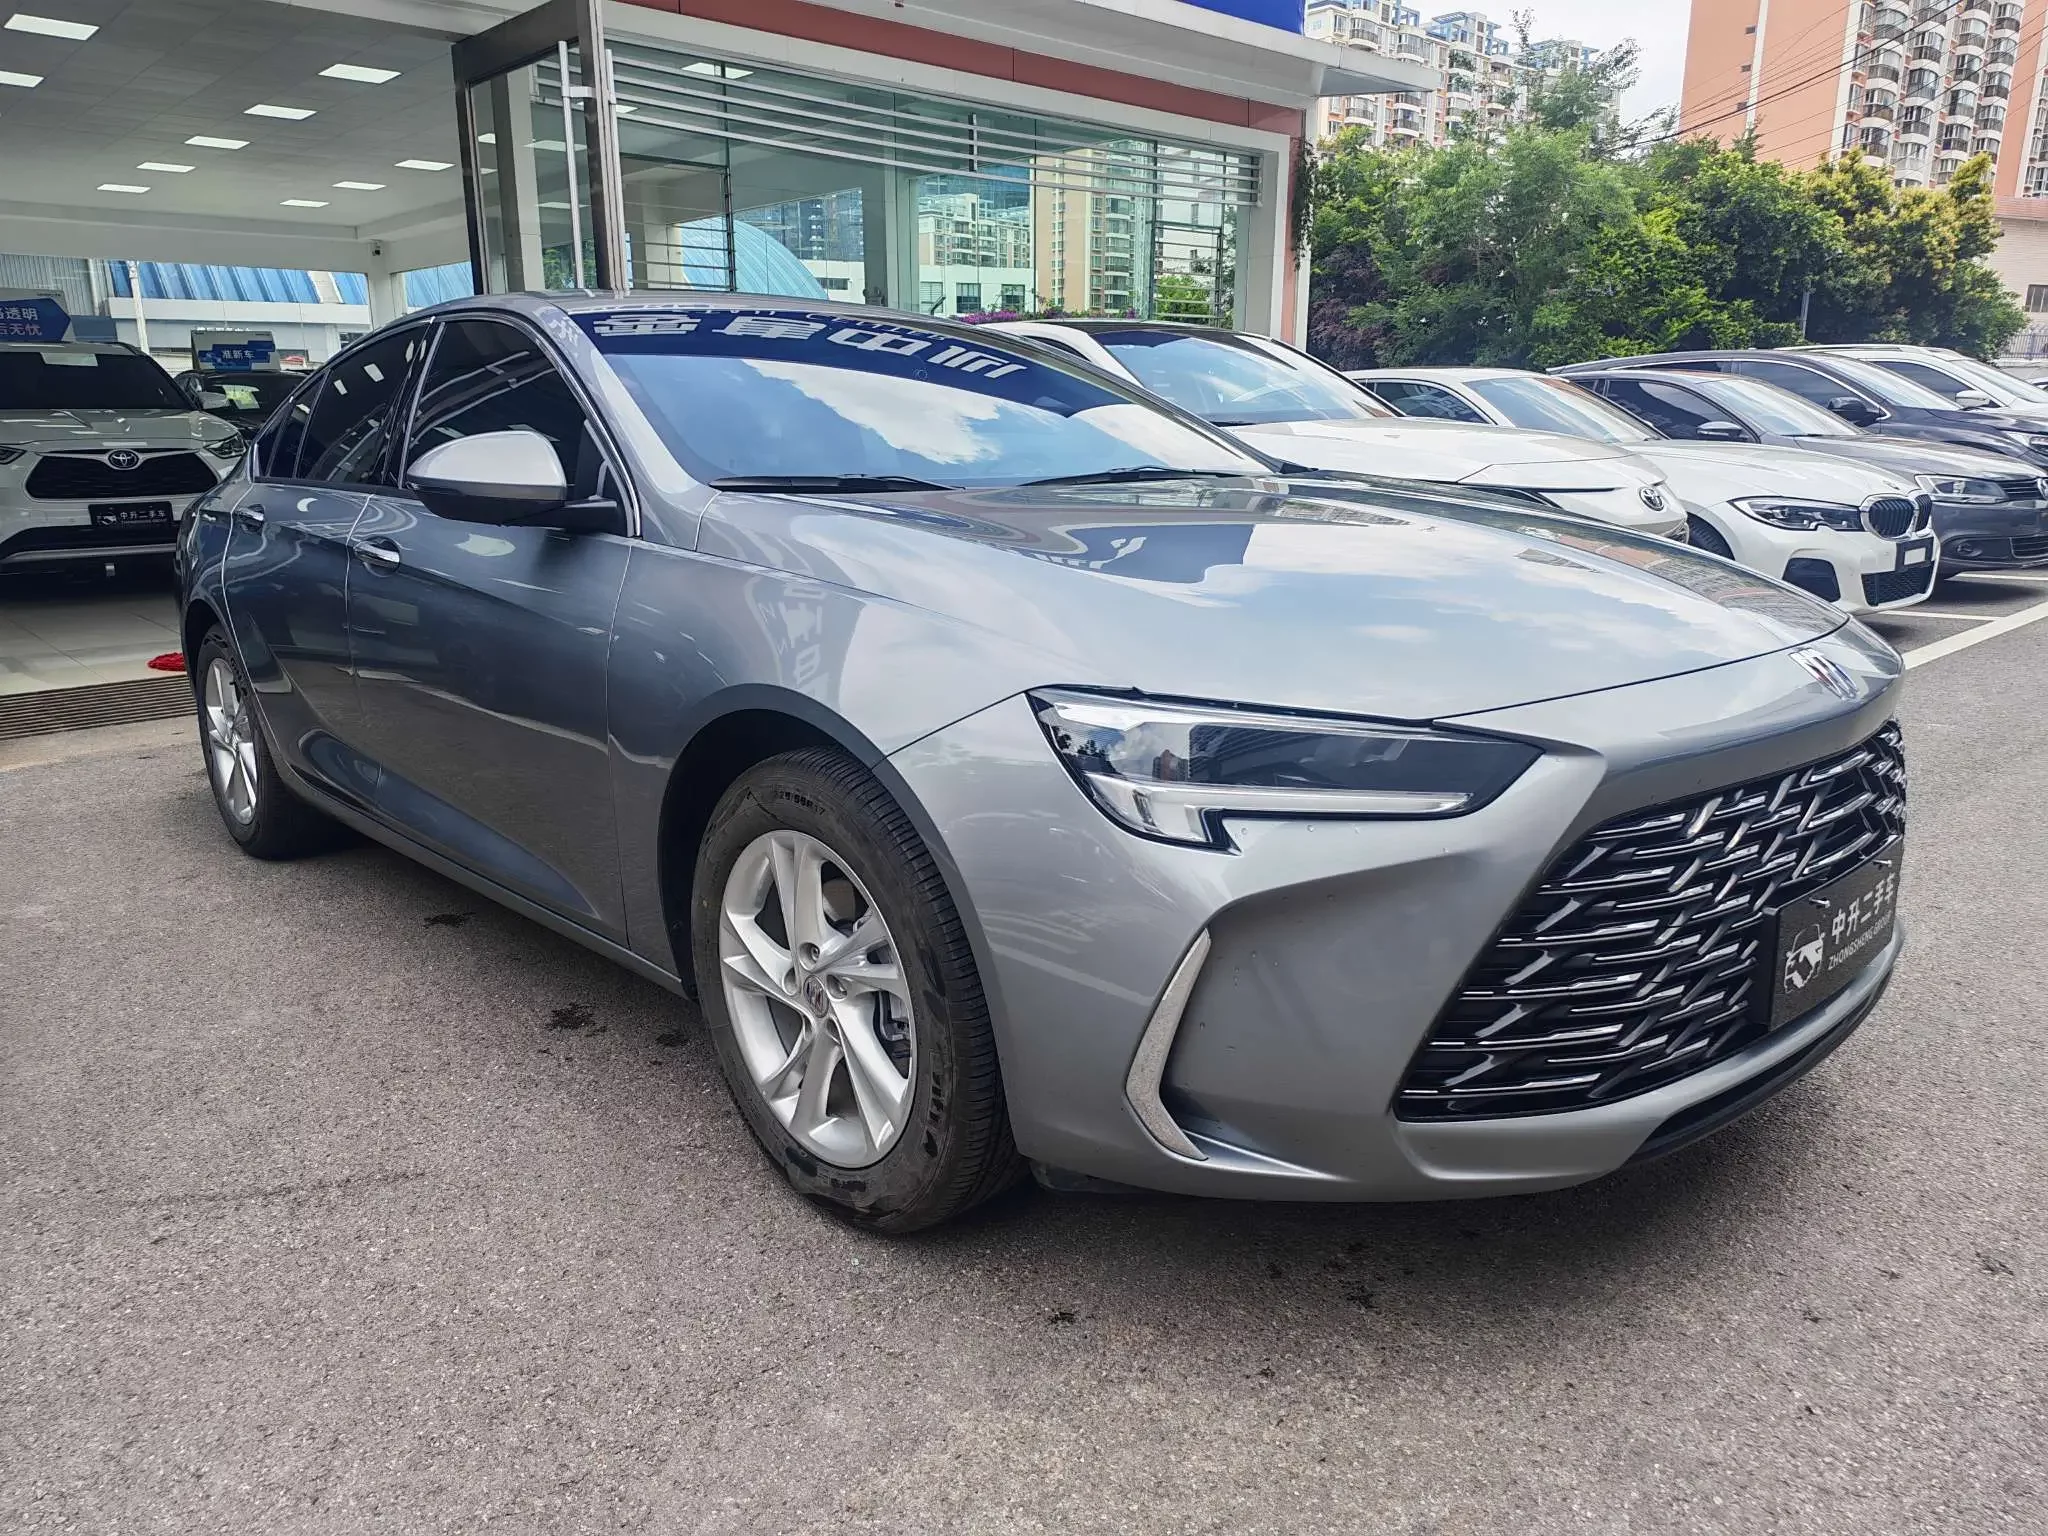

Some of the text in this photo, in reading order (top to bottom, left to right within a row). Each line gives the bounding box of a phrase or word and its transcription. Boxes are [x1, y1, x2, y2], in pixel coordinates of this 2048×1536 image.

[222, 349, 256, 360] 准新车
[120, 509, 166, 519] 中升二手车
[1831, 872, 1896, 945] 中升二手车
[1827, 926, 1873, 971] ZHONGSHENG
